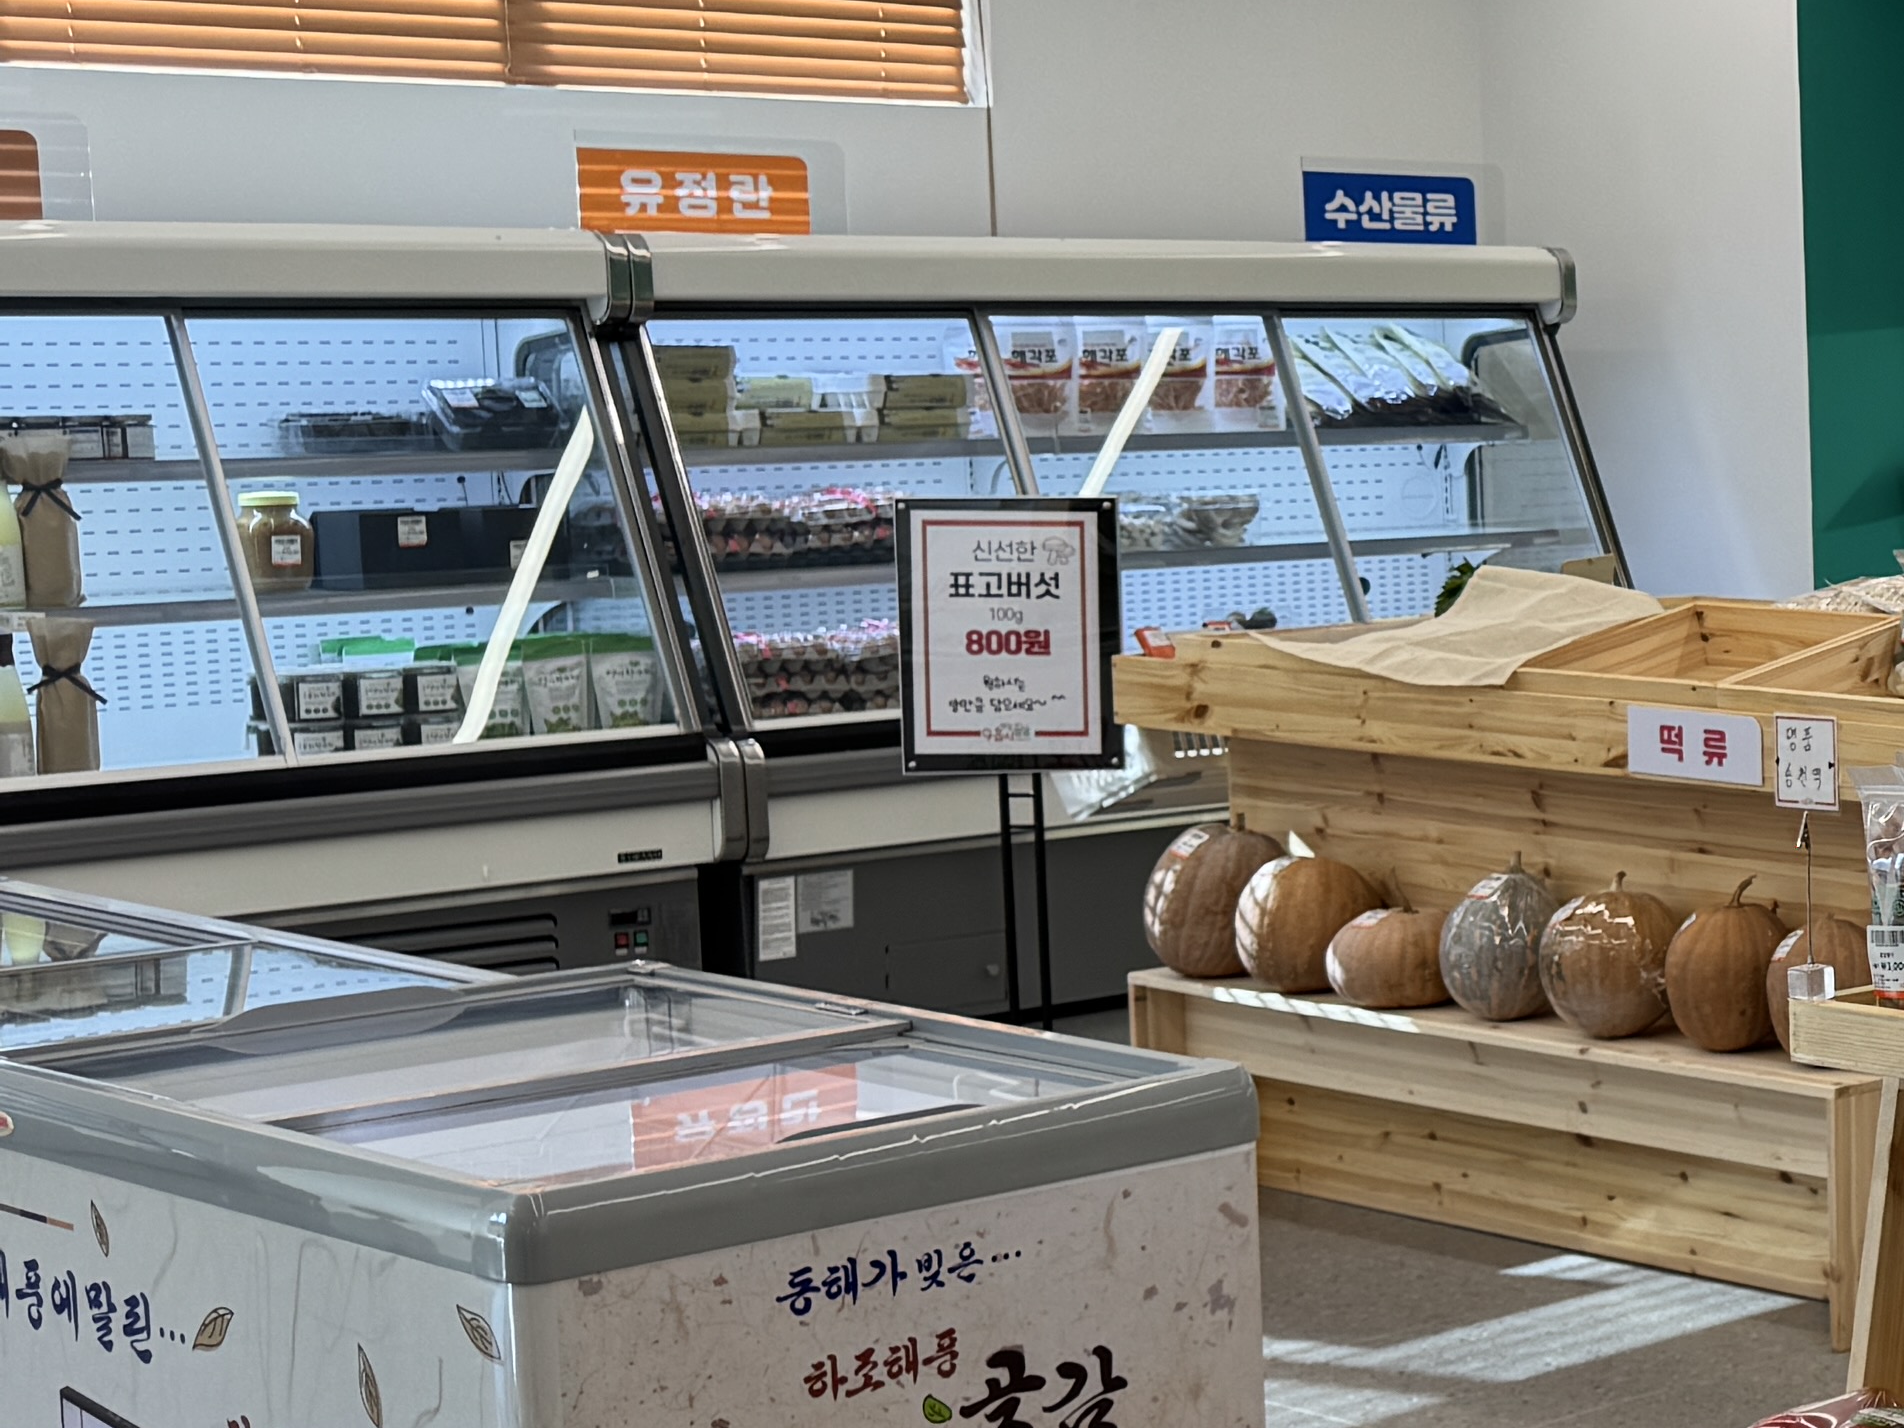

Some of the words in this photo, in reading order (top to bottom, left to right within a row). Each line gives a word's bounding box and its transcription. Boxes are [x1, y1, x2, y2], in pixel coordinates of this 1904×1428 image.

[618, 168, 773, 221] 유정란
[1323, 188, 1459, 233] 수산물류
[972, 539, 1037, 563] 신선한
[949, 571, 1061, 600] 표고버섯
[989, 607, 1024, 624] 100g
[965, 629, 1052, 656] 800원
[775, 1252, 907, 1317] 동해가
